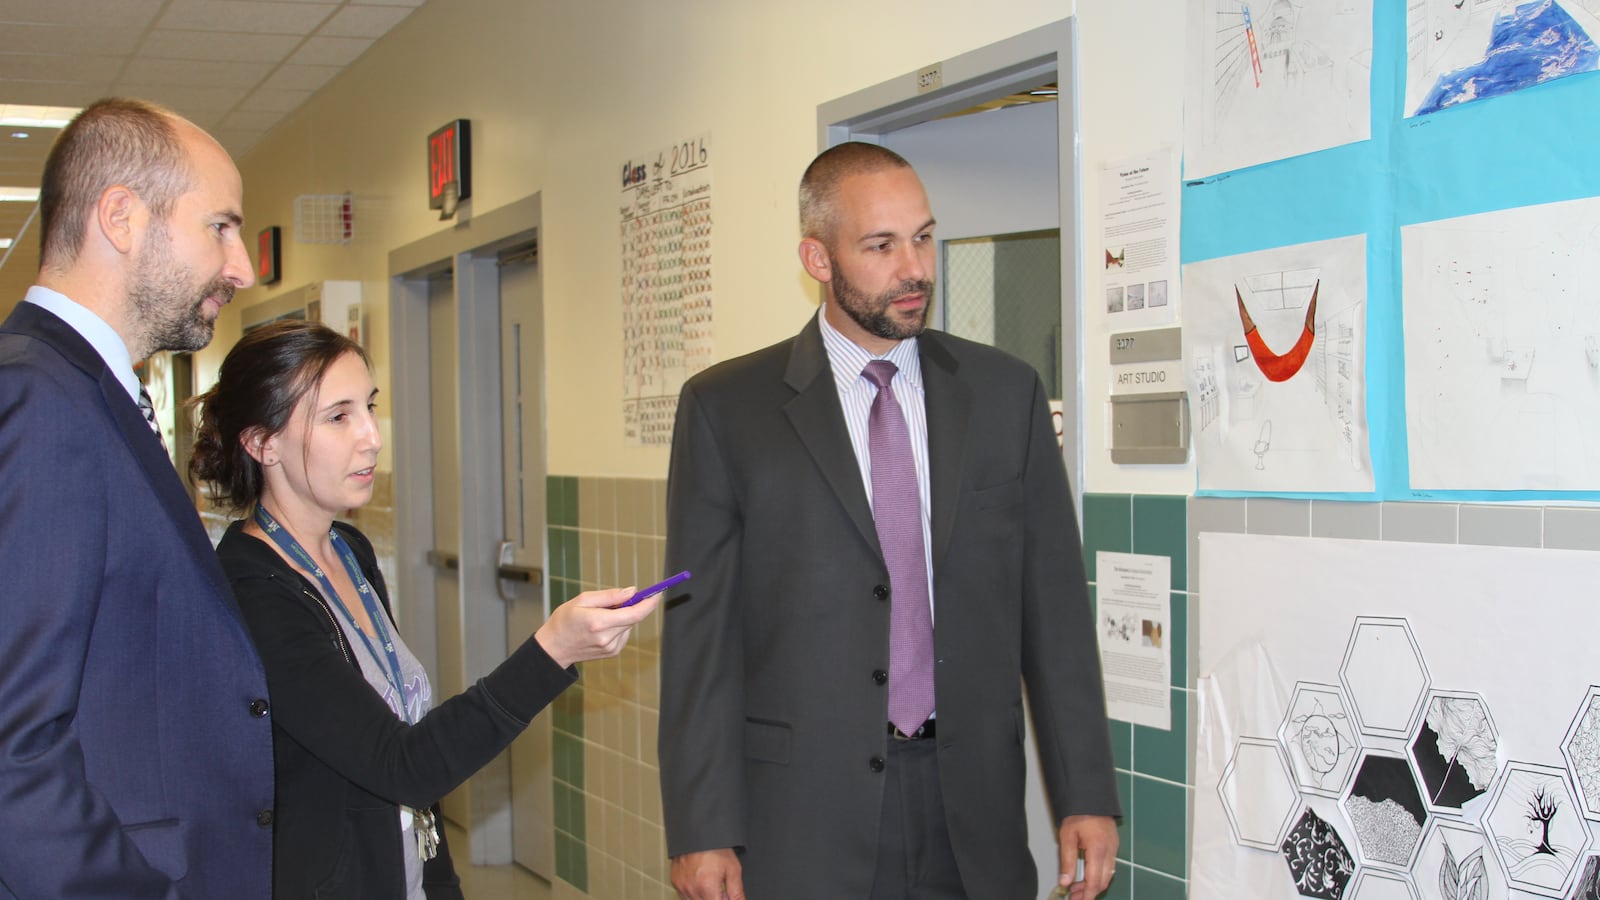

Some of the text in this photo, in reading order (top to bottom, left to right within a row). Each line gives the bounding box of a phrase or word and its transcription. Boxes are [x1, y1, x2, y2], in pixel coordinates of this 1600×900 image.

[431, 127, 454, 199] EXIT
[622, 160, 647, 188] Class
[670, 138, 708, 175] 2016
[1118, 370, 1166, 384] ART STUDIO
